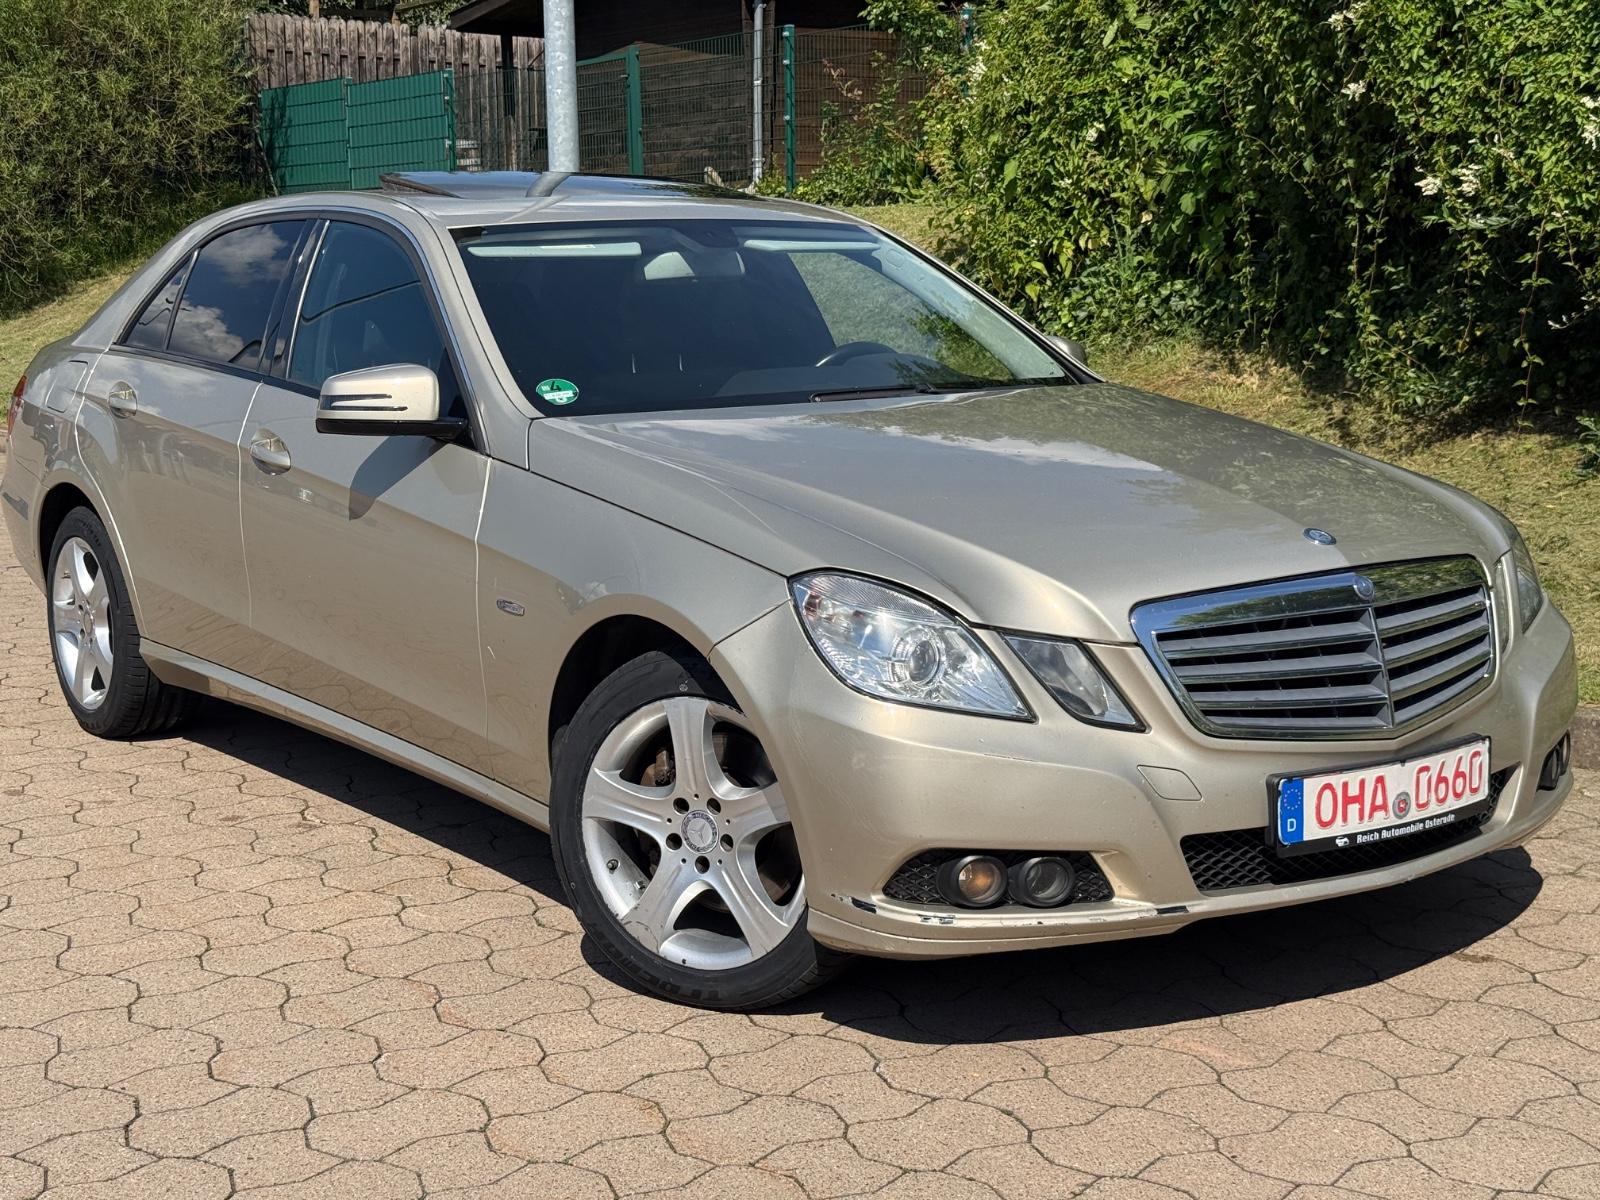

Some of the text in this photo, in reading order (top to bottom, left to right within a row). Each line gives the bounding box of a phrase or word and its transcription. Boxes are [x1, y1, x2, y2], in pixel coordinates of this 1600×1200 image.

[1314, 750, 1483, 830] OHA 0660
[1287, 818, 1296, 832] D
[1356, 831, 1380, 844] Reich
[1381, 822, 1424, 839] Automobile
